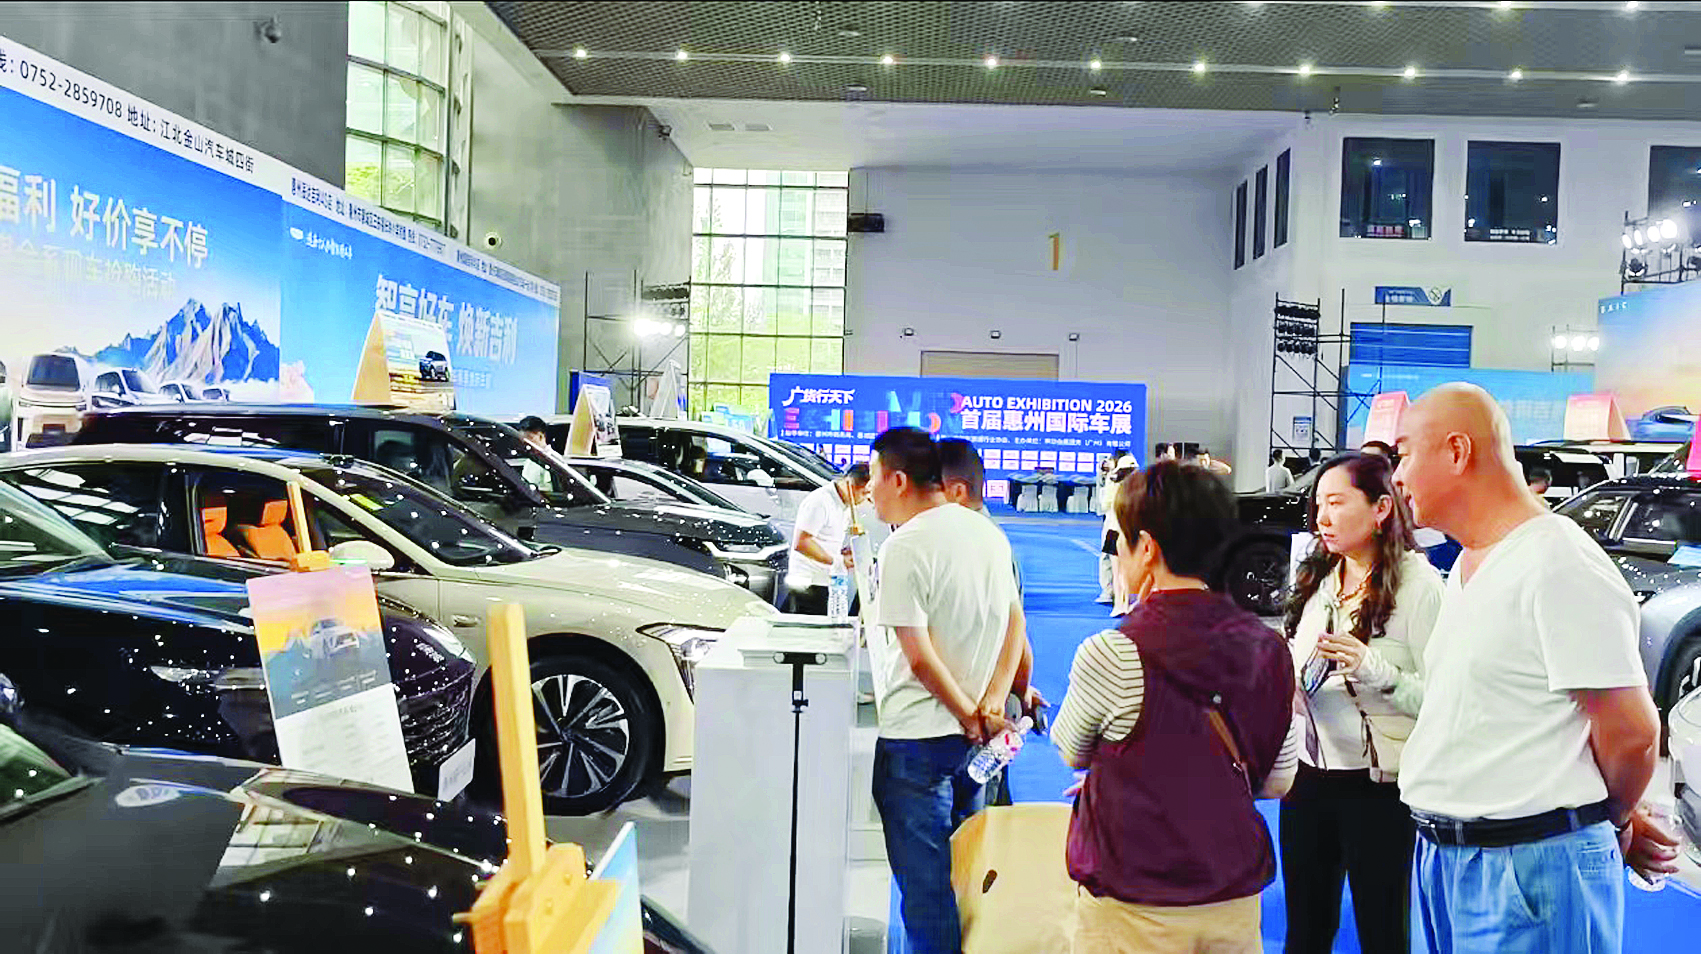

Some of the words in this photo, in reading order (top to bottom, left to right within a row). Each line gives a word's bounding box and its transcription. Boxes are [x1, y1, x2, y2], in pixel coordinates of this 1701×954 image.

[70, 184, 208, 269] 好价享不停
[1049, 232, 1059, 270] 1
[782, 386, 855, 406] 广货行天下
[961, 396, 1003, 409] AUTO
[1007, 397, 1092, 412] EXHIBITION
[1096, 400, 1132, 413] 2026
[961, 409, 1132, 434] 首届惠州国际车展
